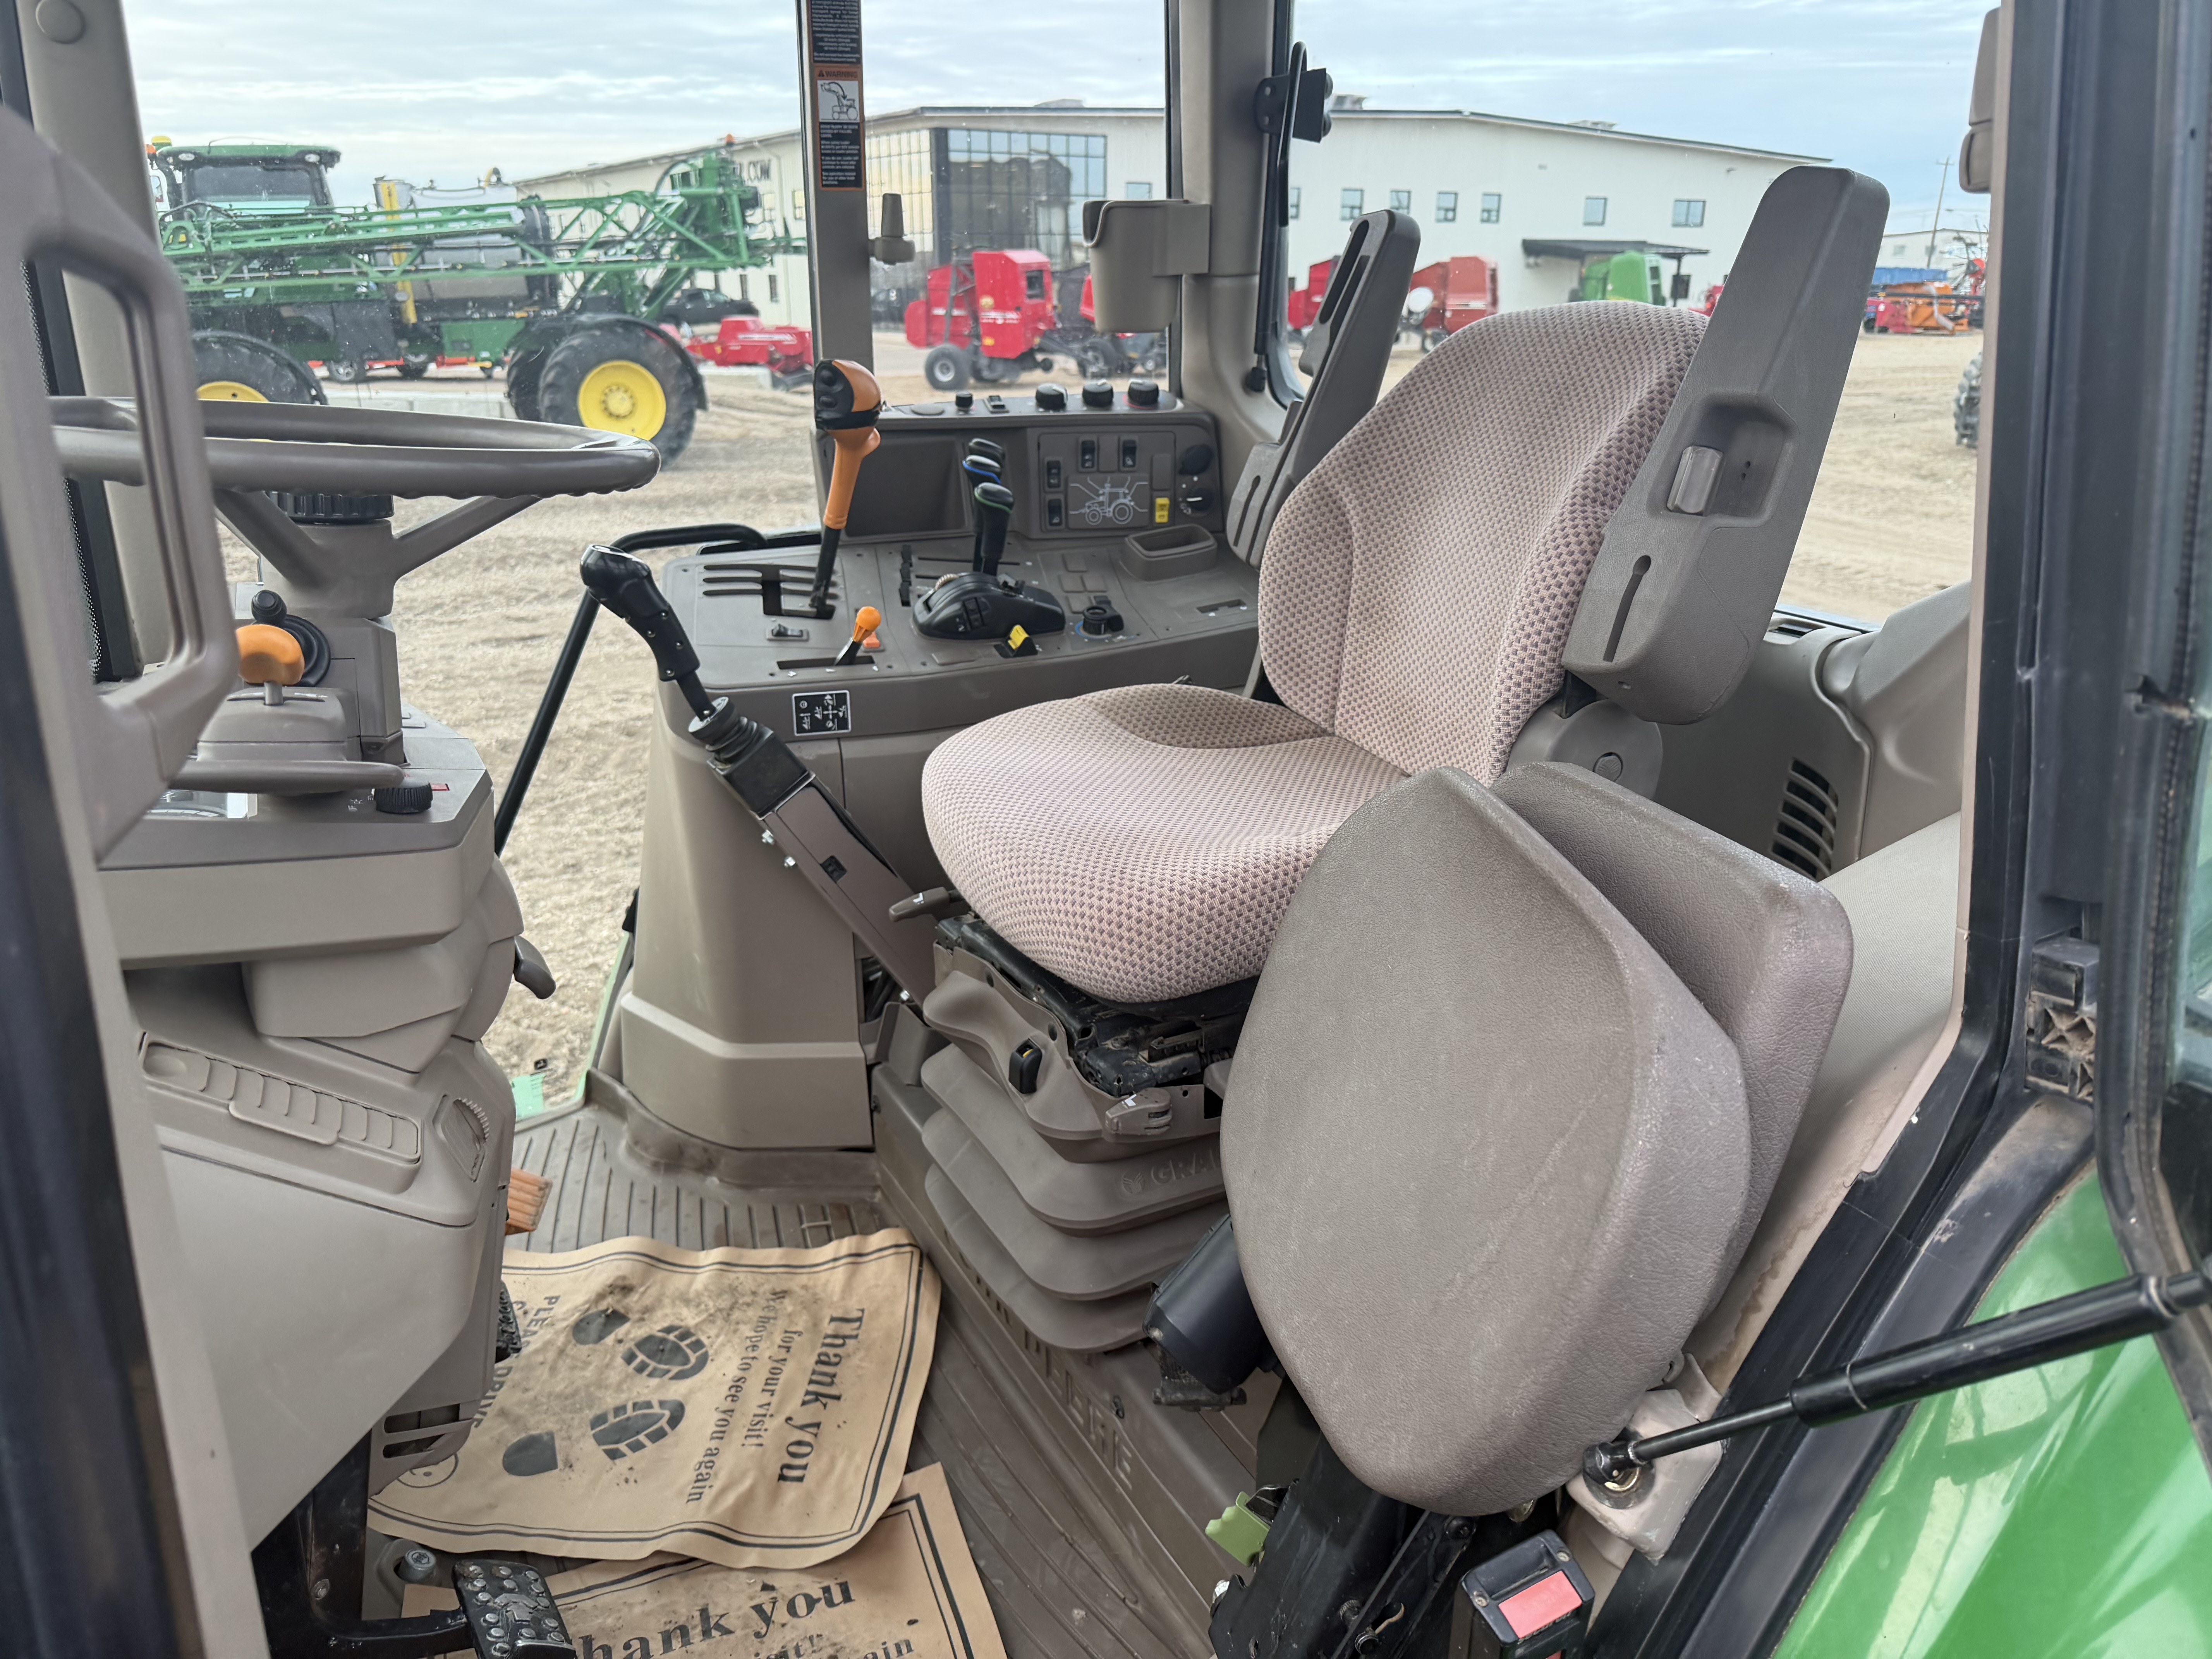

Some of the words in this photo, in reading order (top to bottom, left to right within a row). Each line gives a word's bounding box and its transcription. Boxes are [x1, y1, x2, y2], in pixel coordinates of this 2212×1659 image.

[778, 1329, 804, 1353] for
[800, 1308, 865, 1410] Thank
[725, 1375, 747, 1403] see
[761, 1355, 787, 1396] your
[710, 1407, 735, 1441] you
[741, 1401, 774, 1447] visit!
[778, 1416, 822, 1483] you
[686, 1446, 720, 1504] again
[579, 1604, 735, 1659] hank
[750, 1580, 855, 1638] you
